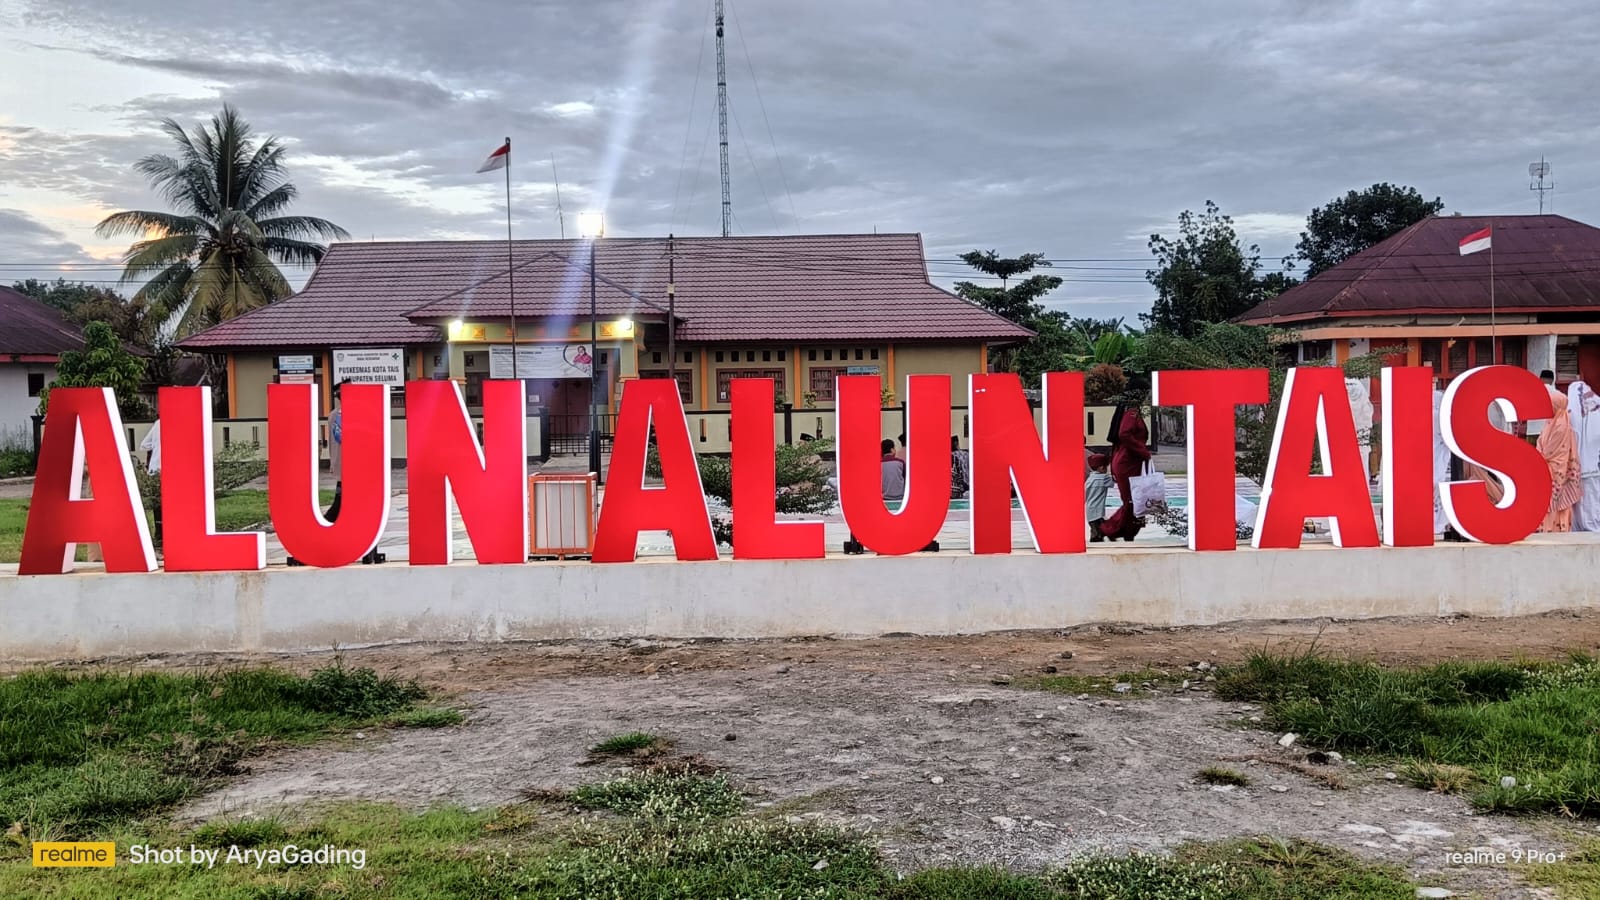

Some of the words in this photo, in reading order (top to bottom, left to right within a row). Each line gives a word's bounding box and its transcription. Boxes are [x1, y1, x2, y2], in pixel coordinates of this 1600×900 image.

[339, 366, 371, 374] PUSKESMAS
[388, 365, 400, 373] TAIS
[18, 380, 528, 575] ALUN
[591, 372, 1086, 562] ALUN
[1152, 364, 1554, 551] TAIS
